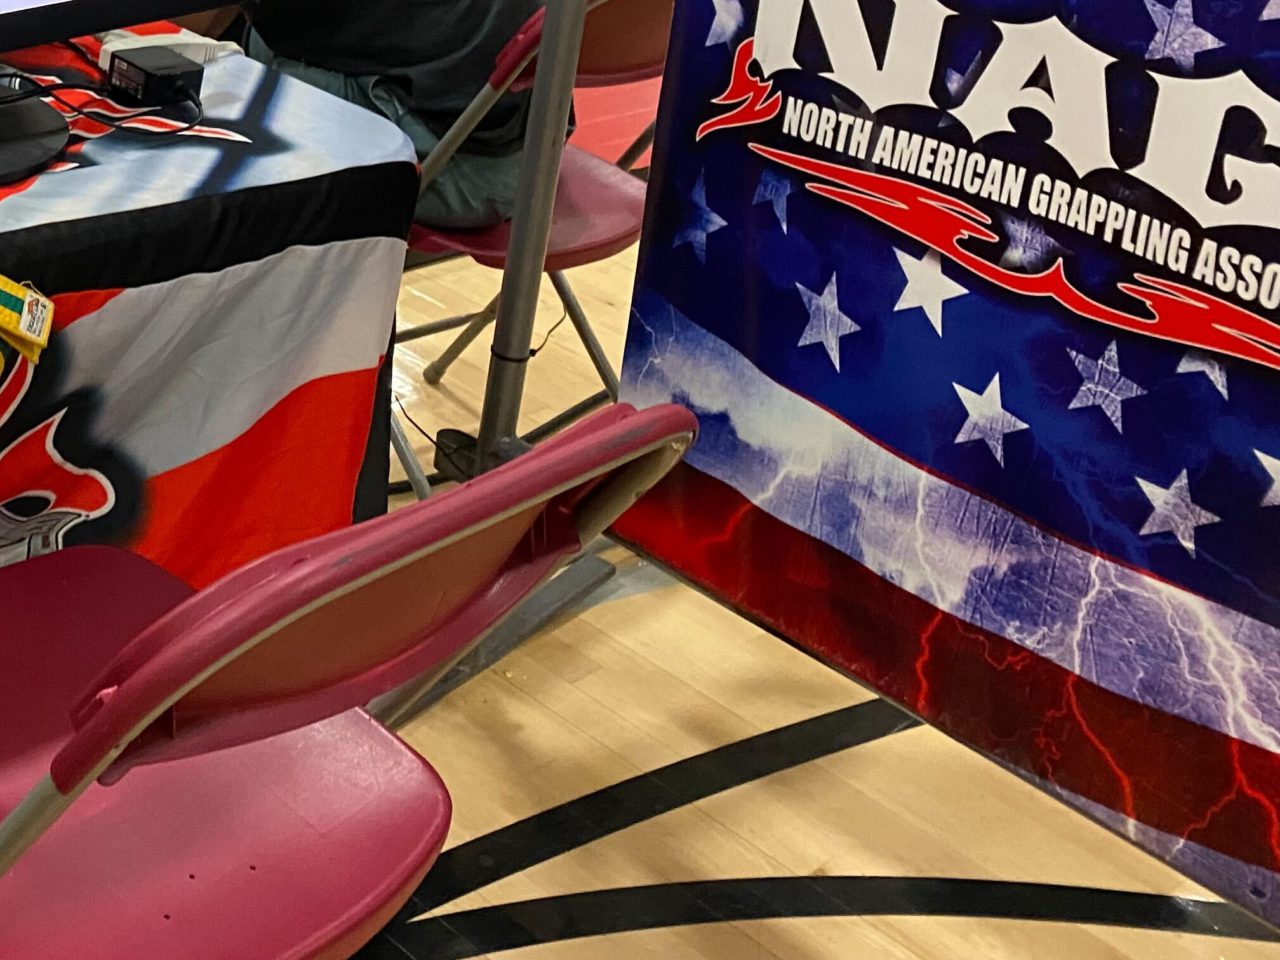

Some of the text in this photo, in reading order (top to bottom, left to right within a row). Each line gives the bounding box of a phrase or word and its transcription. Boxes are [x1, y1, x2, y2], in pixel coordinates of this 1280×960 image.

[781, 96, 874, 160] NORTH
[873, 125, 1027, 208] AMERICAN
[1028, 176, 1196, 273] GRAPPLING
